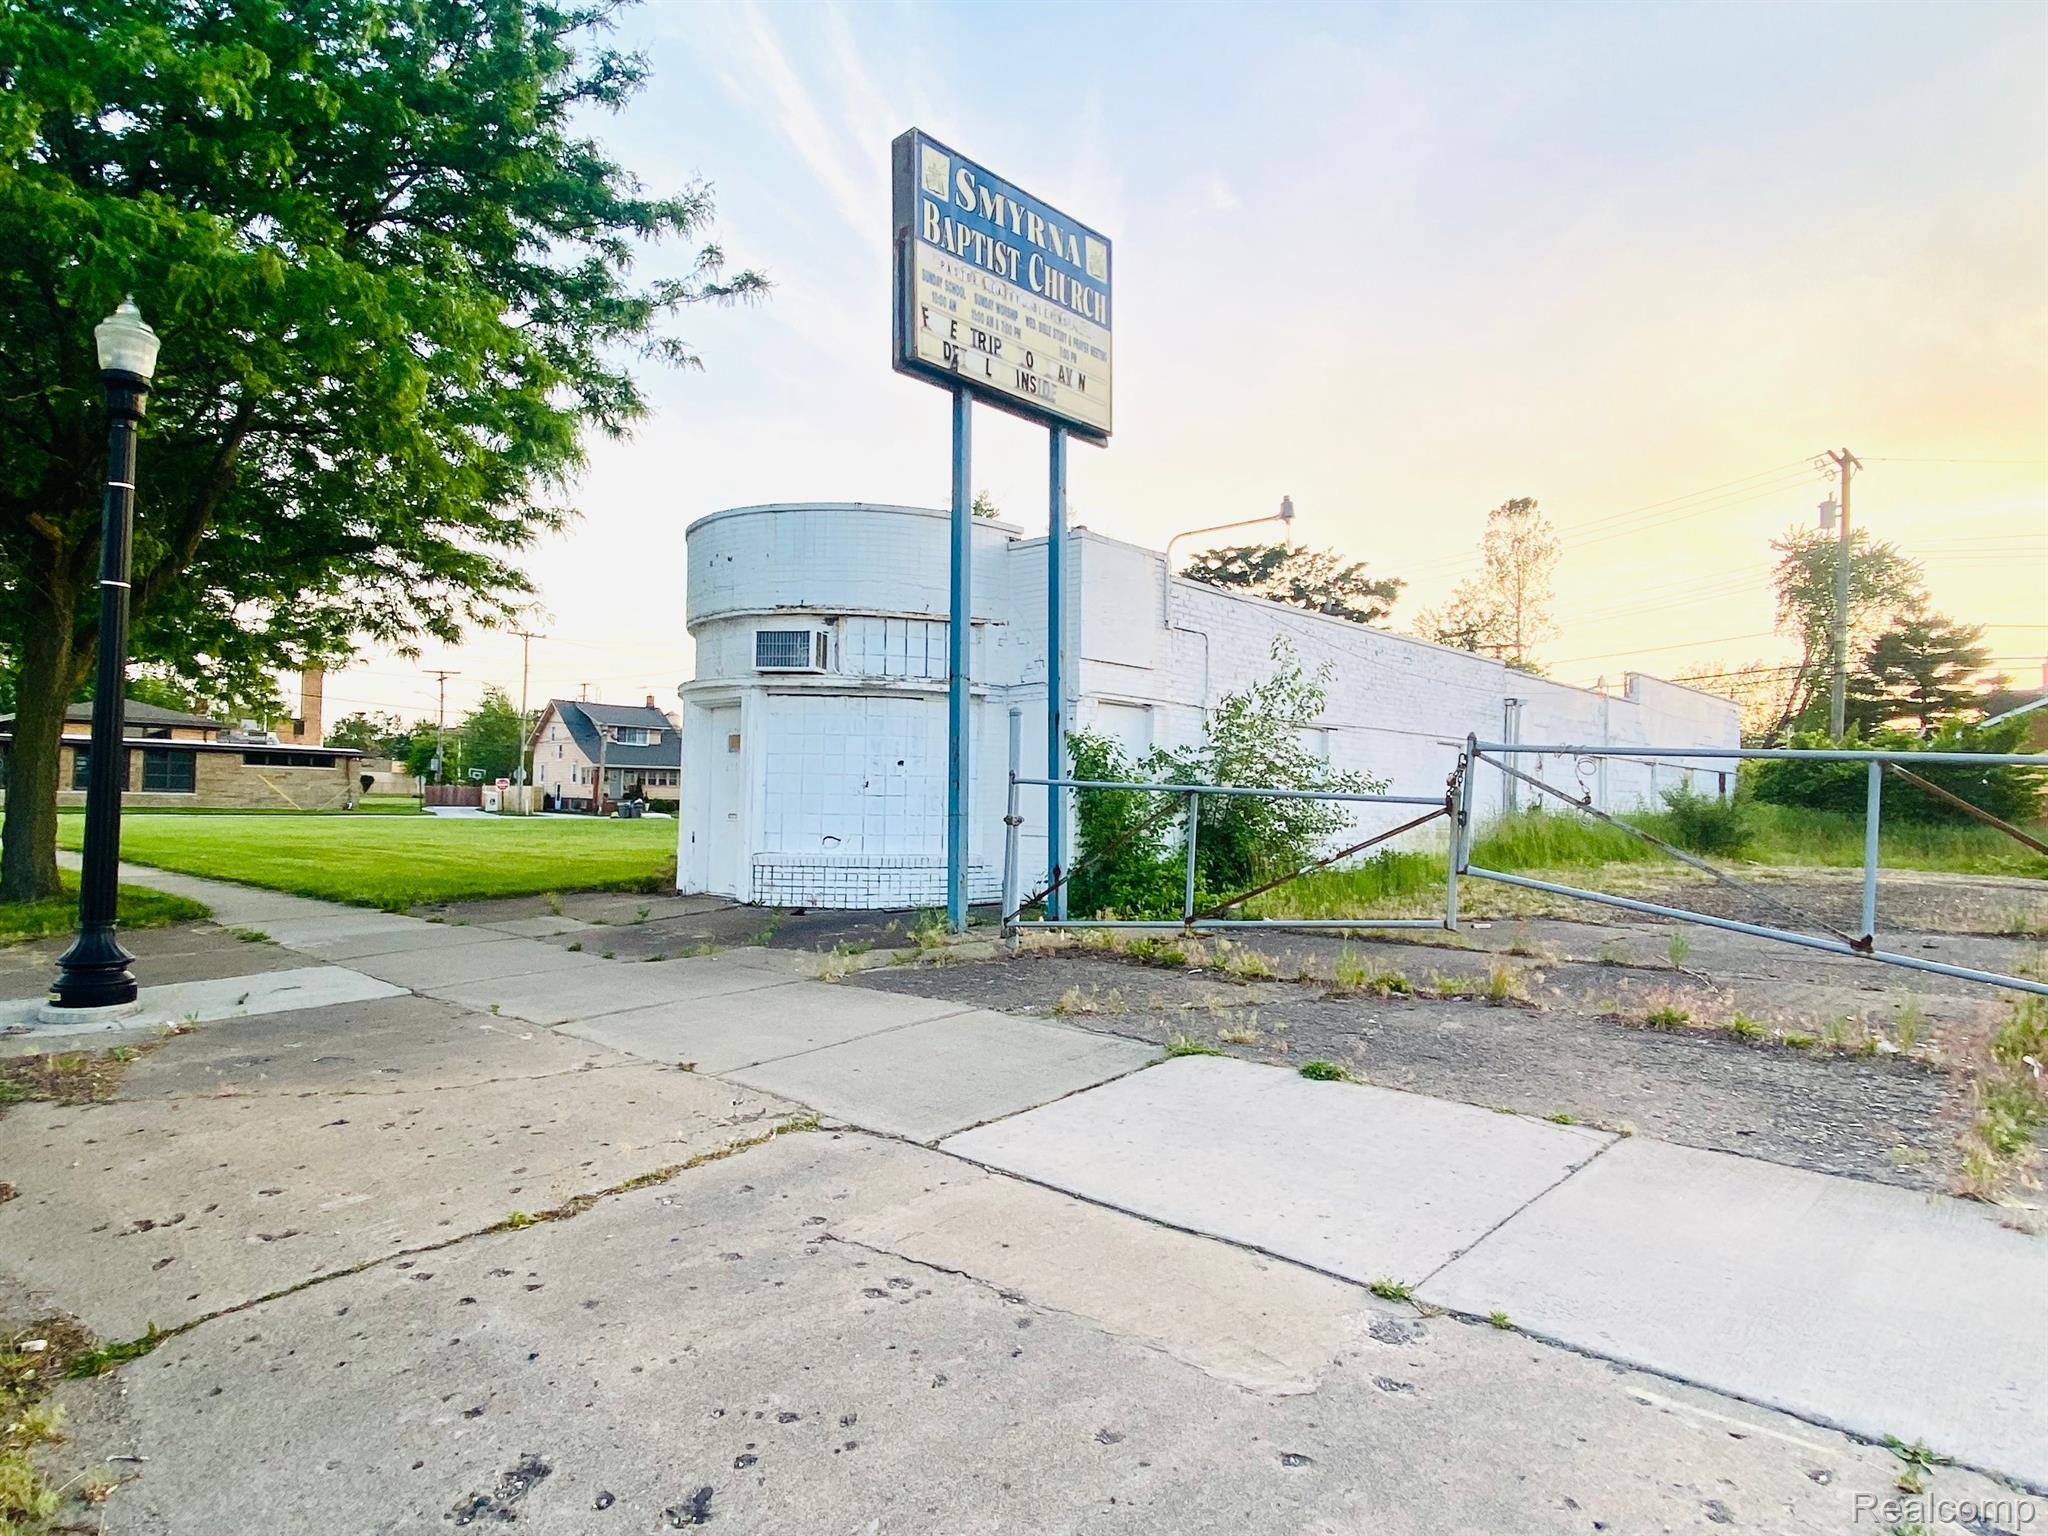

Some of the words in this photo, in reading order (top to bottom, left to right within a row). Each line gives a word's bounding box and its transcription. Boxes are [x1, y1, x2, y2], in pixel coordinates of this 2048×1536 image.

[955, 167, 1082, 268] SMYRNA
[922, 198, 1020, 284] BAPTIST
[1029, 252, 1106, 324] CHURCH
[951, 320, 958, 339] E
[971, 328, 1002, 358] TRIP
[1017, 370, 1057, 403] INSIDE
